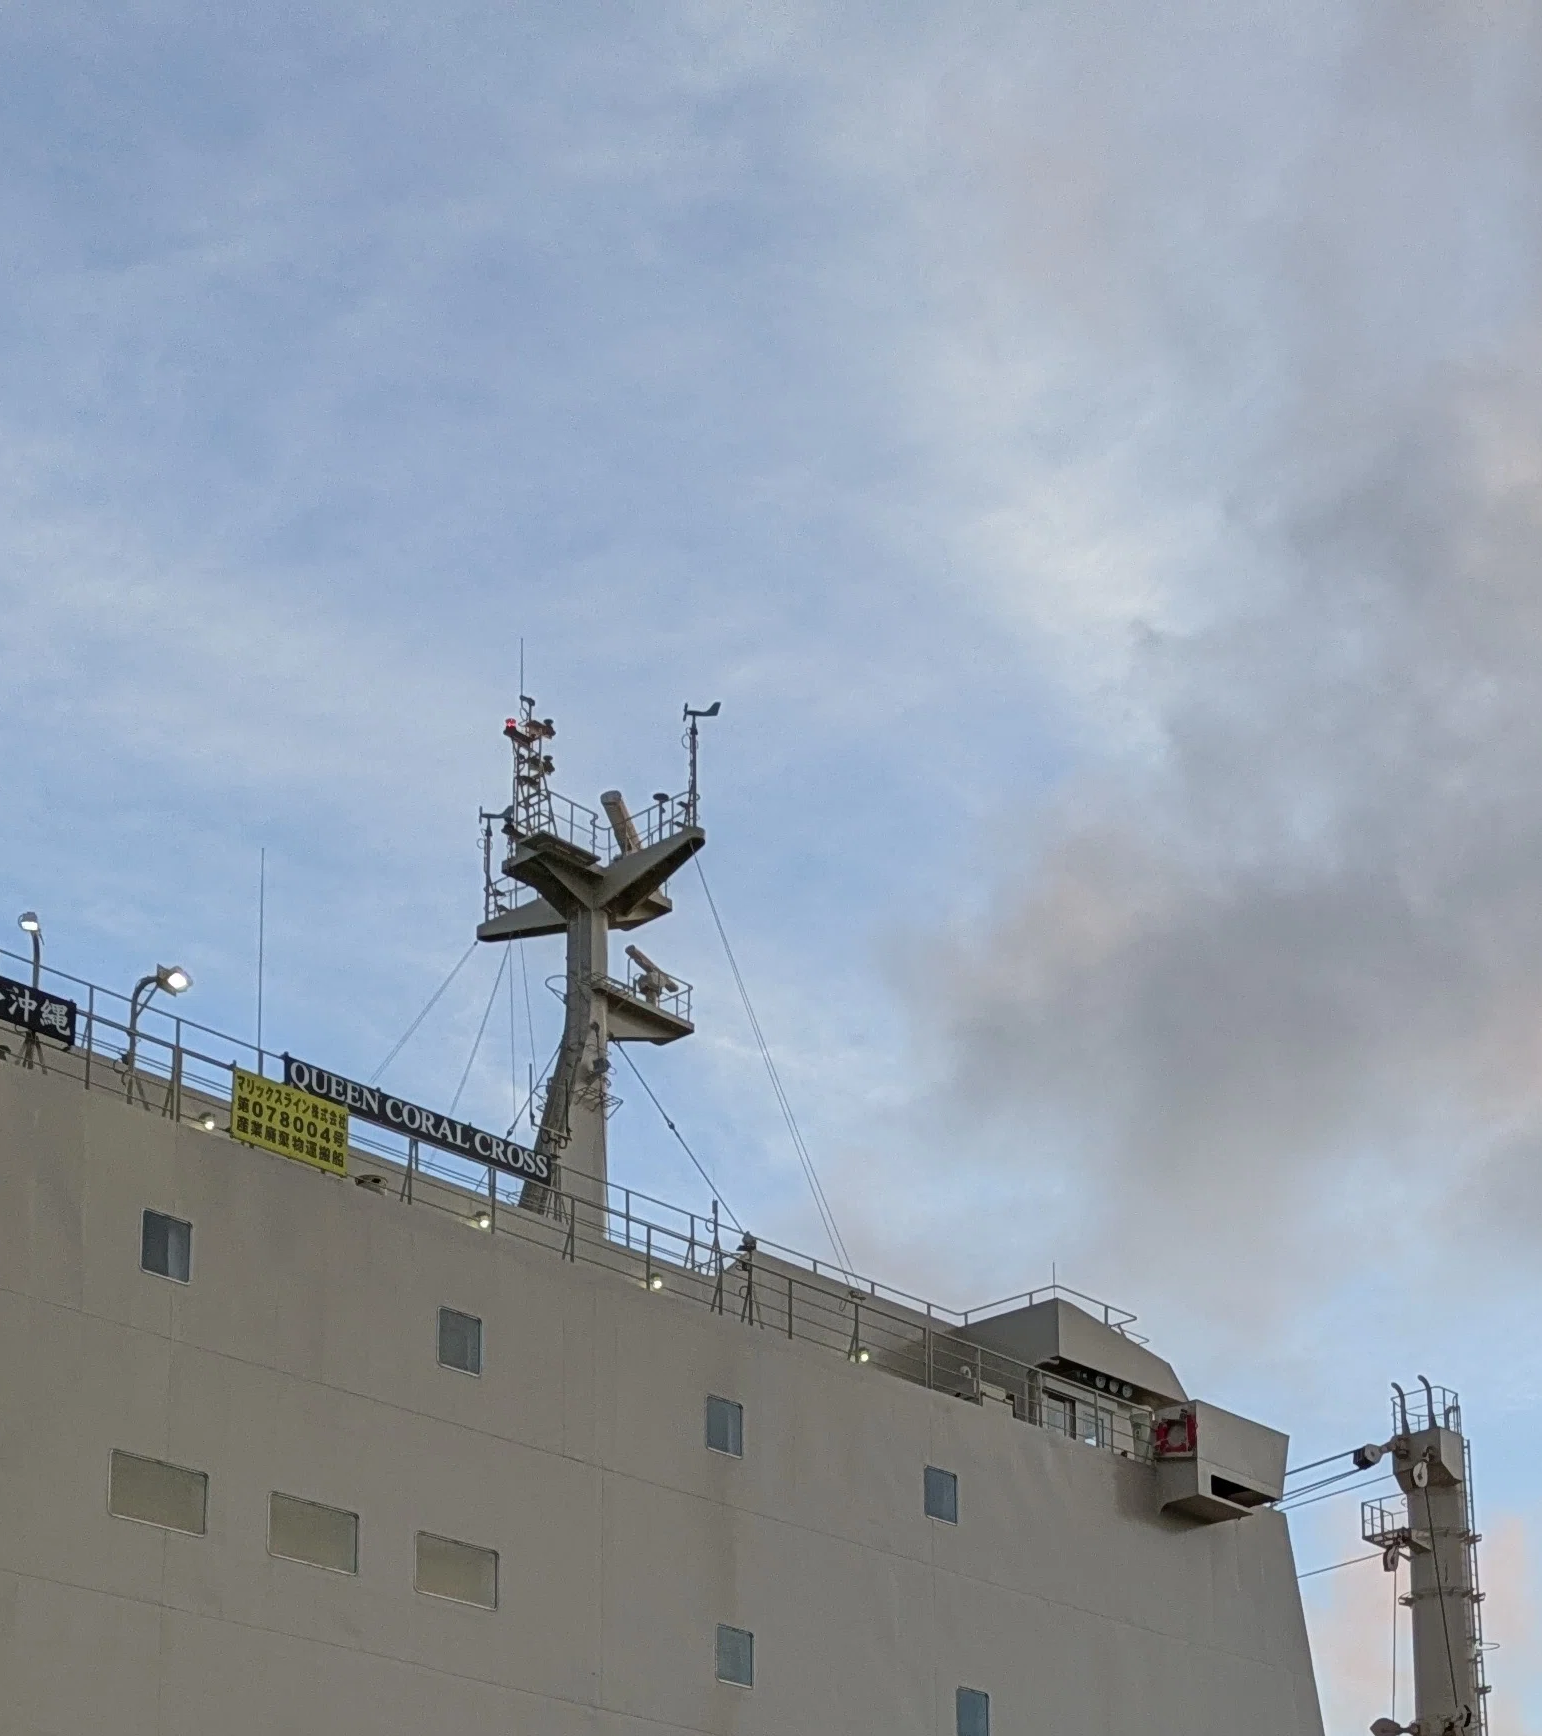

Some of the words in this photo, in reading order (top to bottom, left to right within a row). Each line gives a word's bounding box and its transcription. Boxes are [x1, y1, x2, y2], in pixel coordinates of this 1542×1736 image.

[7, 985, 72, 1037] 沖縄
[236, 1074, 347, 1131] マリックスライン株式会社
[236, 1094, 345, 1149] 第078004号
[289, 1060, 381, 1116] QUEEN
[384, 1097, 470, 1150] CORAL
[474, 1131, 549, 1178] CROSS
[236, 1114, 345, 1169] 産業廃棄物運搬船
